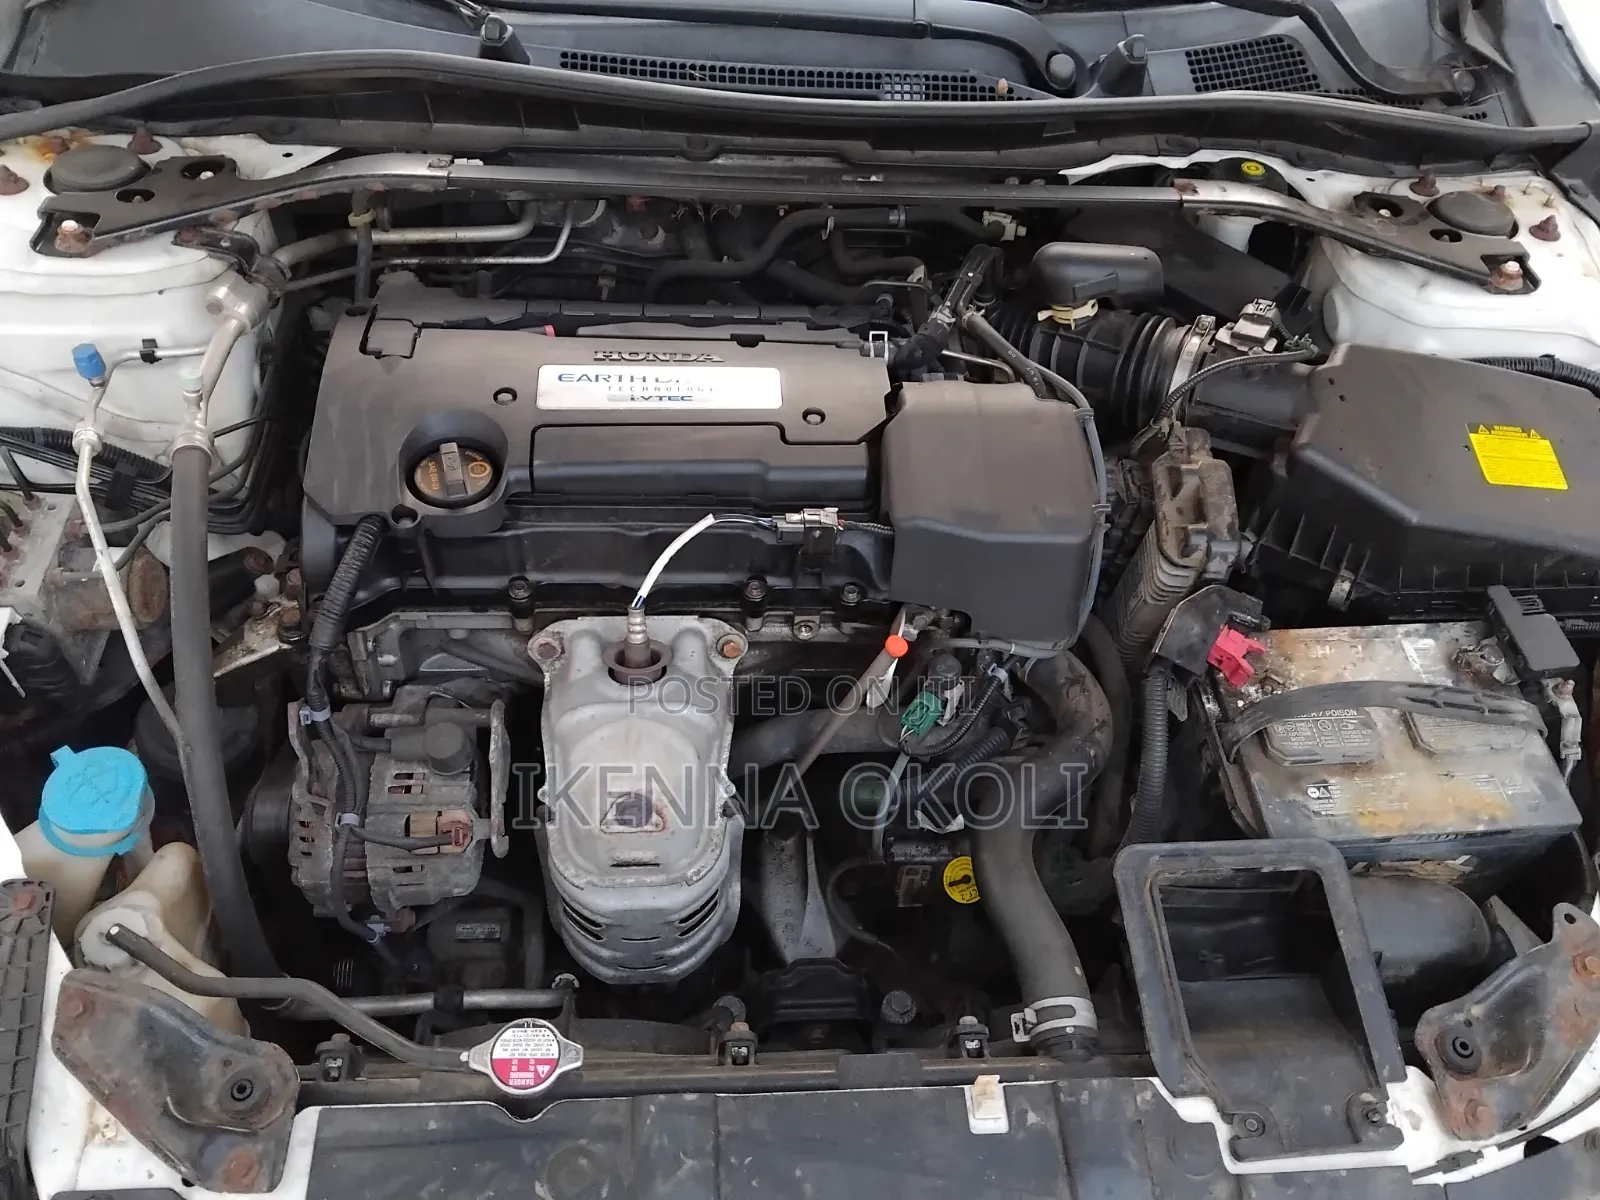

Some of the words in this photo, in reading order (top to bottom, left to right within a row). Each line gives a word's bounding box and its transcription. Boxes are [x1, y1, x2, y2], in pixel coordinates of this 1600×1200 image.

[593, 350, 725, 363] HONDA
[557, 373, 647, 383] EARTH
[1325, 708, 1358, 716] POISON
[508, 1078, 535, 1086] DANGER
